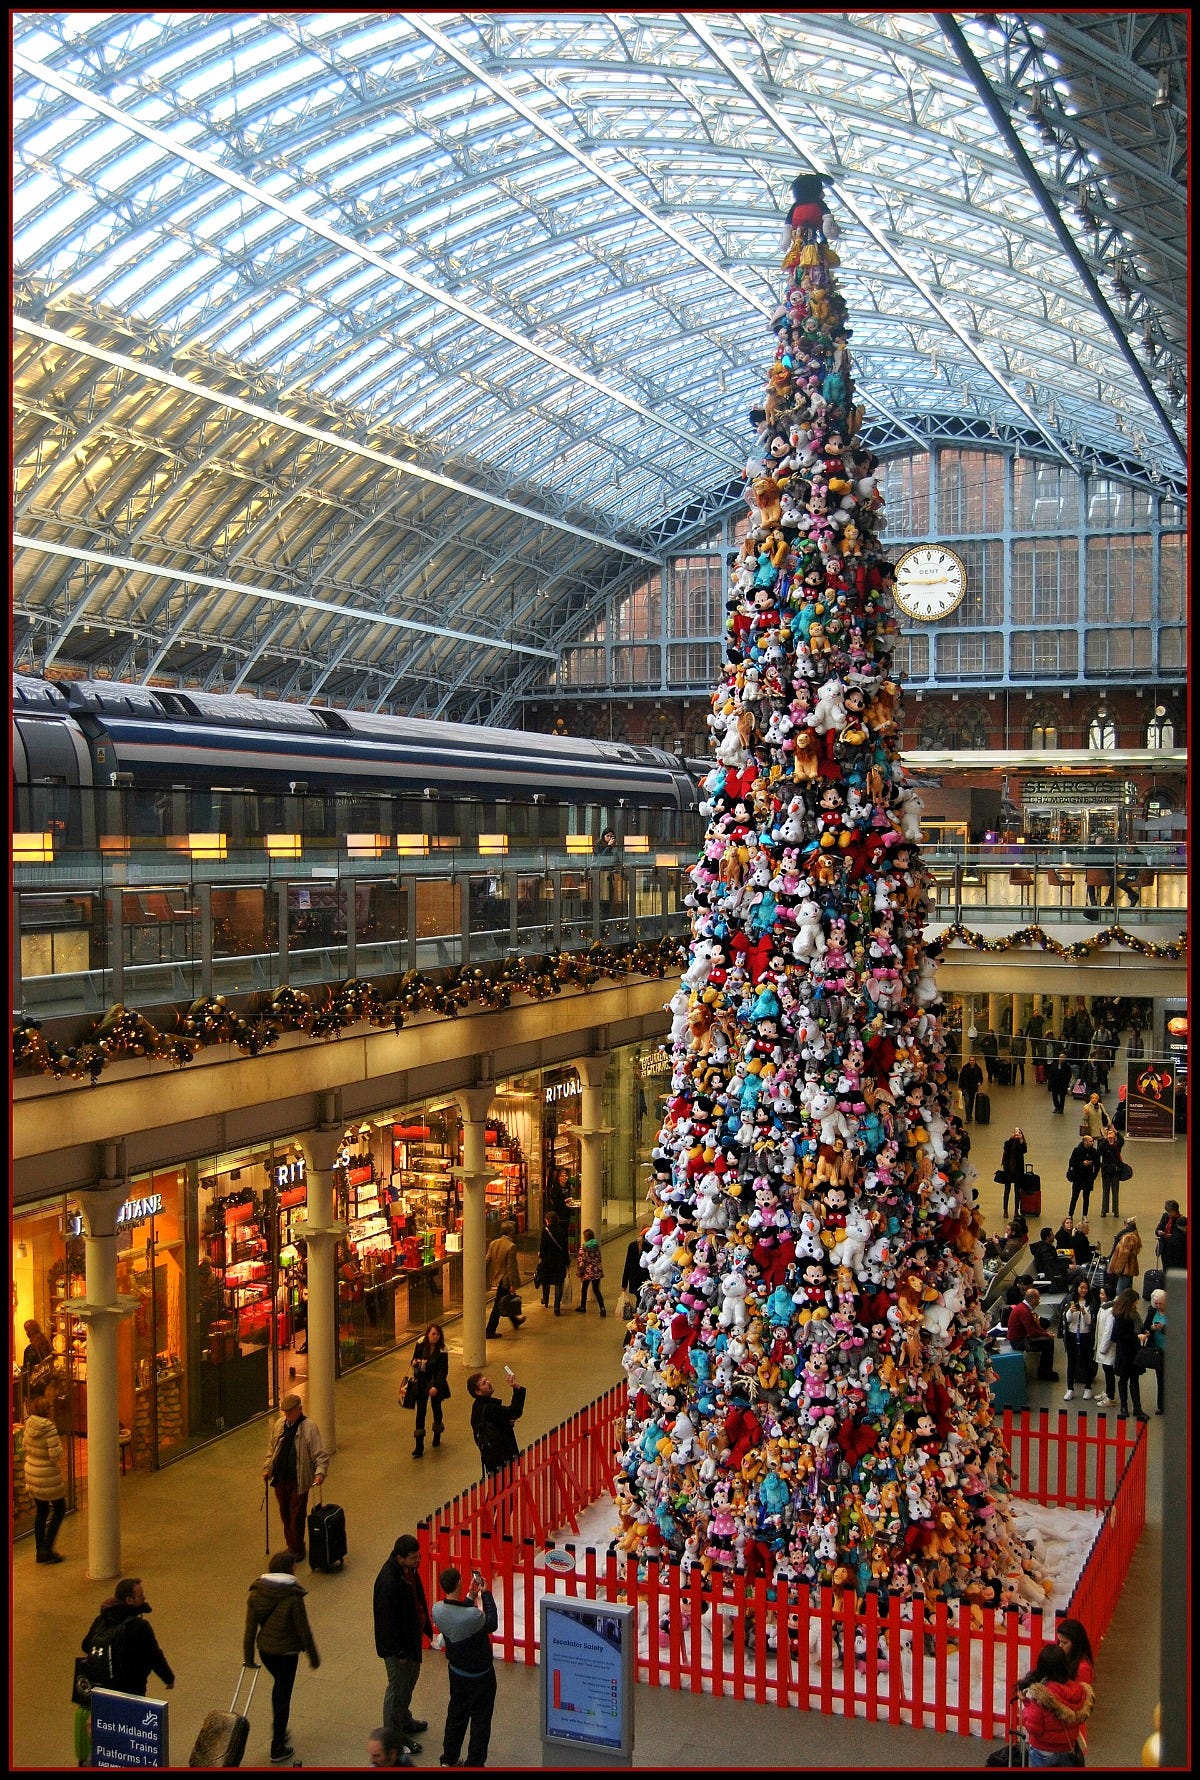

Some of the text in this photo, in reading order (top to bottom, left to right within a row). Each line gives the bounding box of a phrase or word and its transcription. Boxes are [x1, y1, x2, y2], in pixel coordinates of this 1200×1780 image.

[1024, 780, 1114, 794] SEARCYS
[1029, 796, 1089, 804] CHAMPAGNE
[545, 1079, 583, 1103] RITUAL
[552, 1638, 604, 1653] Escalator Safety
[96, 1719, 158, 1741] East Midlands
[129, 1739, 158, 1754] Trains
[96, 1745, 158, 1768] Platforms 1-4
